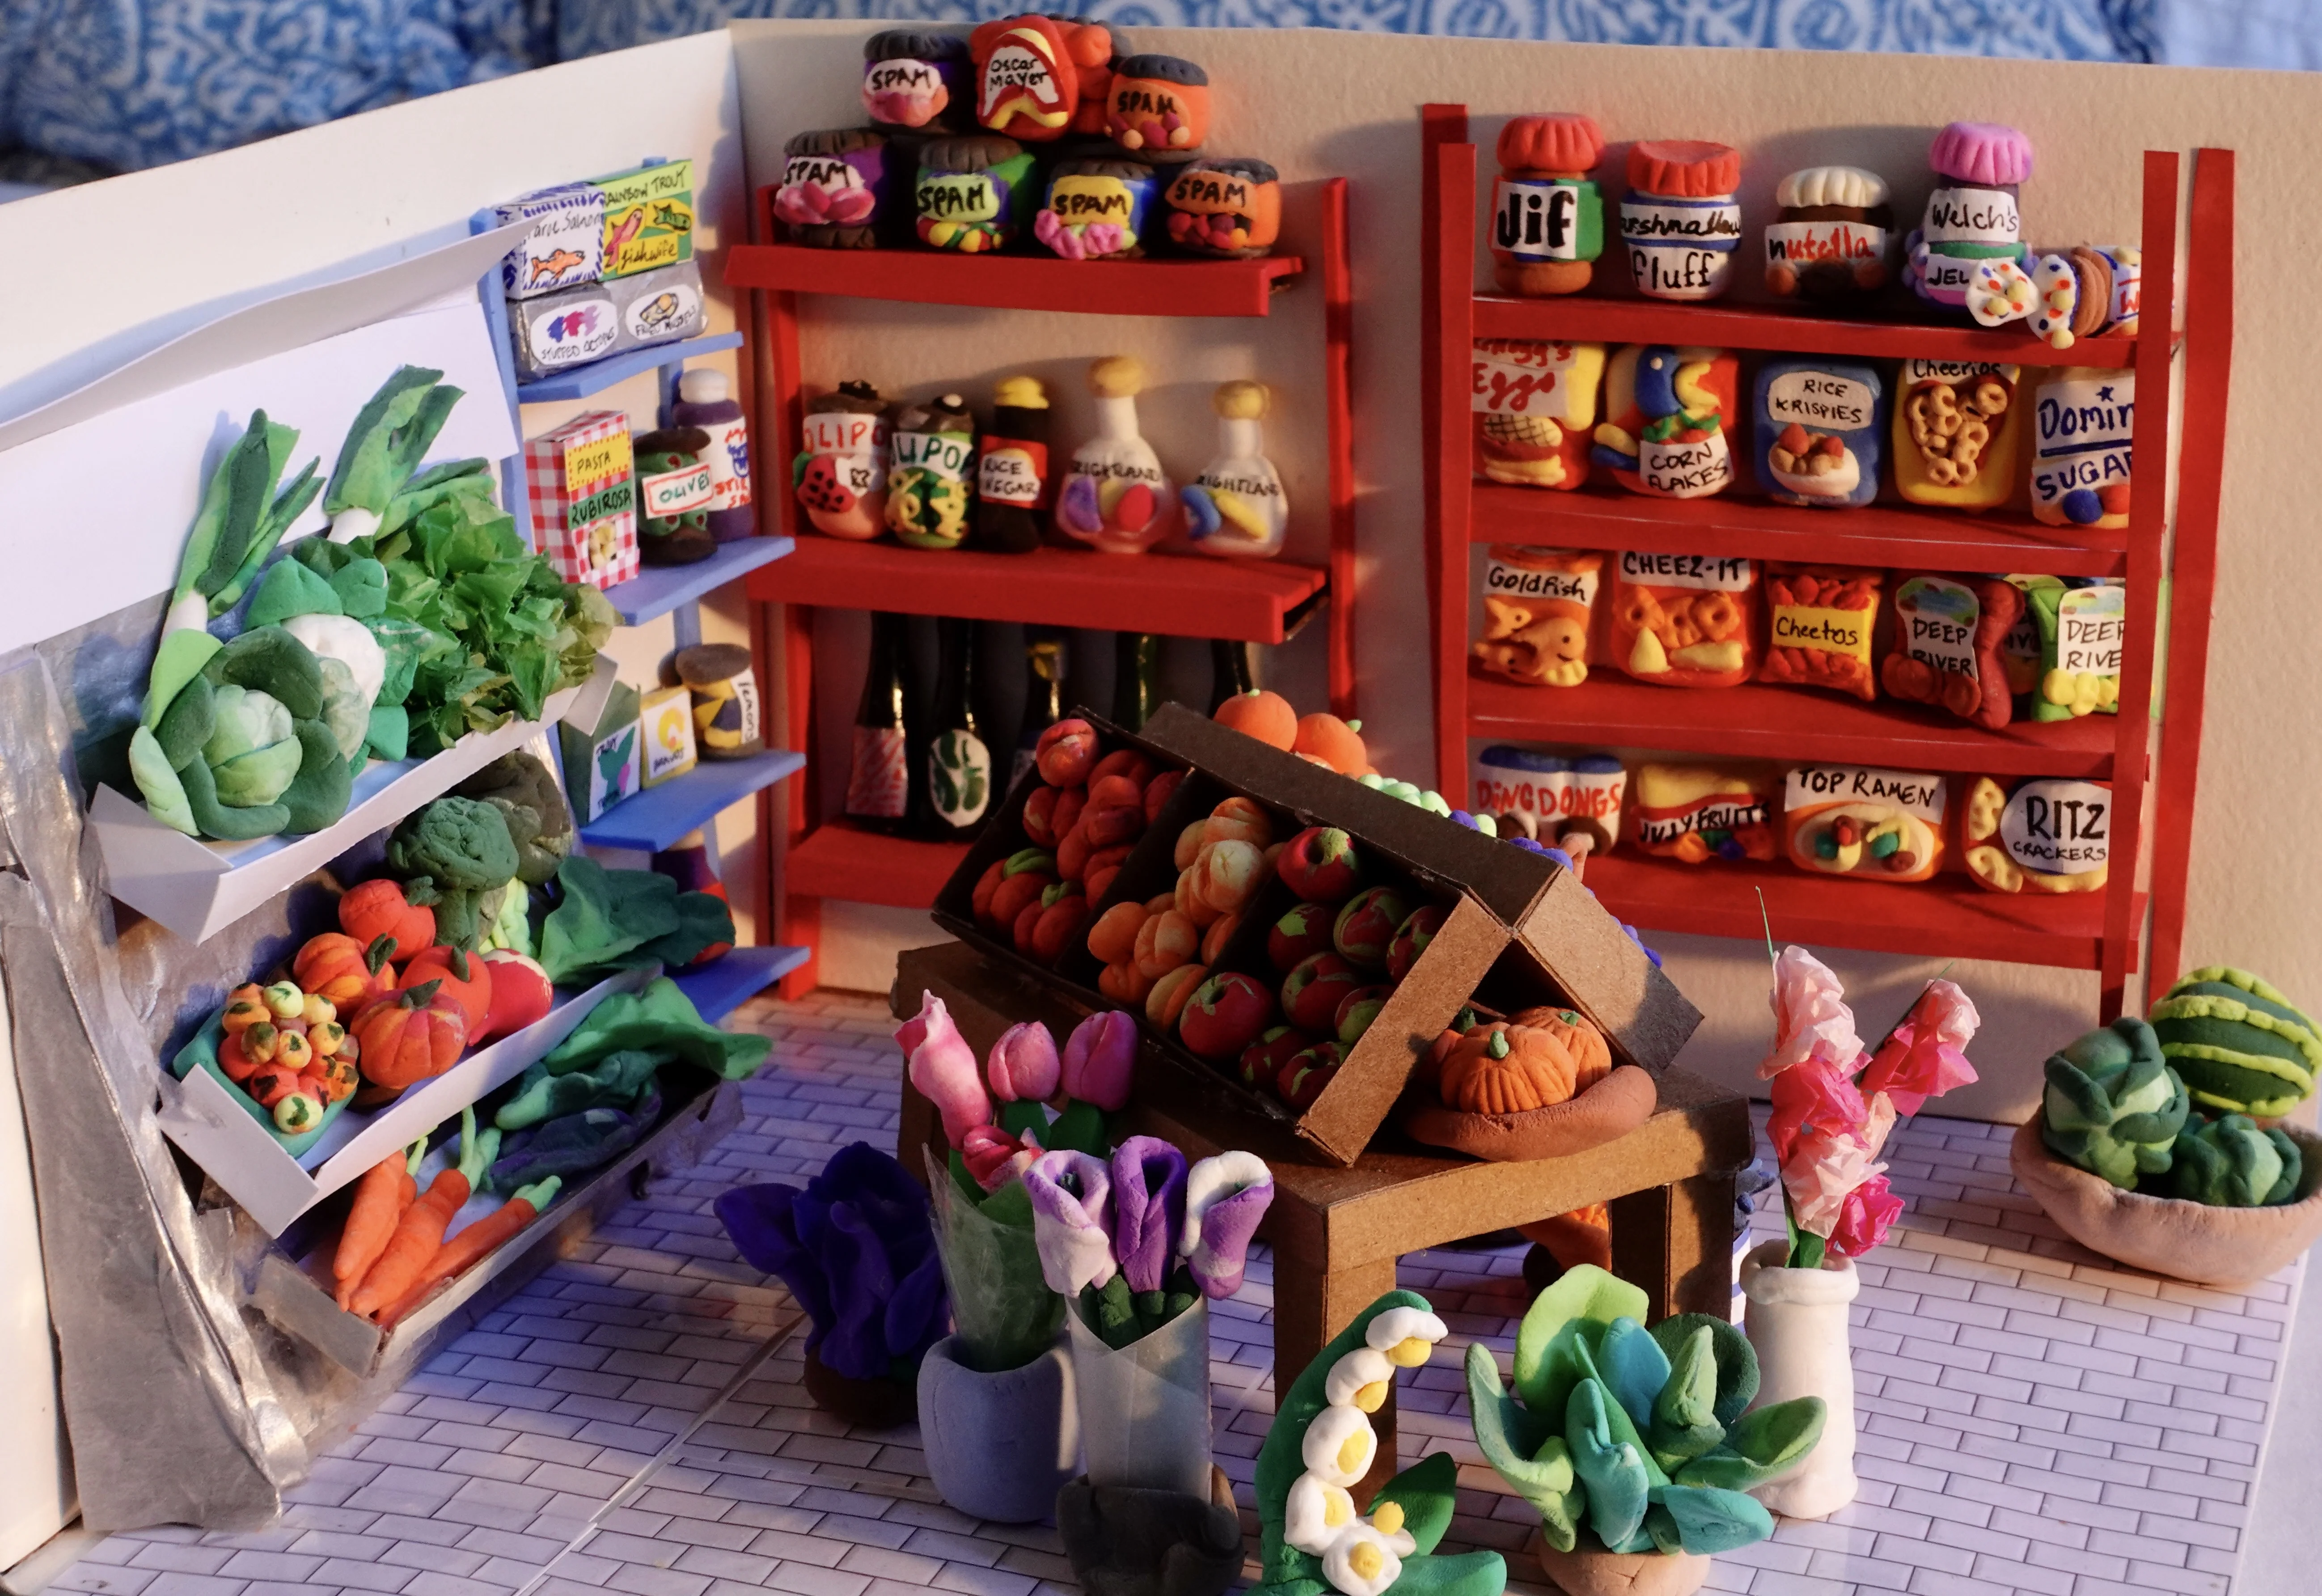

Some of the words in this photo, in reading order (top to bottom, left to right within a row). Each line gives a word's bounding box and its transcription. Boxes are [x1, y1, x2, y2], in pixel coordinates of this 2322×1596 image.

[871, 66, 931, 90] SPAM
[990, 57, 1039, 72] Oscar
[1118, 90, 1178, 115] SPAM
[605, 182, 647, 207] AINBOW
[651, 165, 687, 193] TROUT
[784, 161, 850, 188] SPAM
[918, 182, 985, 217] SPAM
[1054, 193, 1128, 215] SPAM
[1175, 178, 1246, 208] SPAM
[1932, 202, 2018, 233] Welch's
[1769, 225, 1876, 260] nutella
[1928, 266, 1969, 285] JEL
[541, 345, 580, 360] STUFFED
[1802, 378, 1848, 398] RICE
[1775, 398, 1863, 424] KRISPIES
[2038, 397, 2135, 440] Domin
[804, 421, 885, 453] OLIPO
[577, 450, 611, 474] PASTA
[1649, 441, 1713, 472] CORN
[1647, 461, 1730, 492] FLAKES
[571, 487, 632, 525] RUBIROSA
[1623, 550, 1743, 581] CHEEZ-IT
[1775, 615, 1859, 648] Cheetos
[1912, 617, 1968, 646] DEEP
[2066, 648, 2122, 670] RIVE
[1798, 768, 1845, 795] TOP
[1853, 773, 1935, 807] RAMEN
[2026, 795, 2105, 841] RITZ
[2012, 841, 2107, 862] CRACKERS
